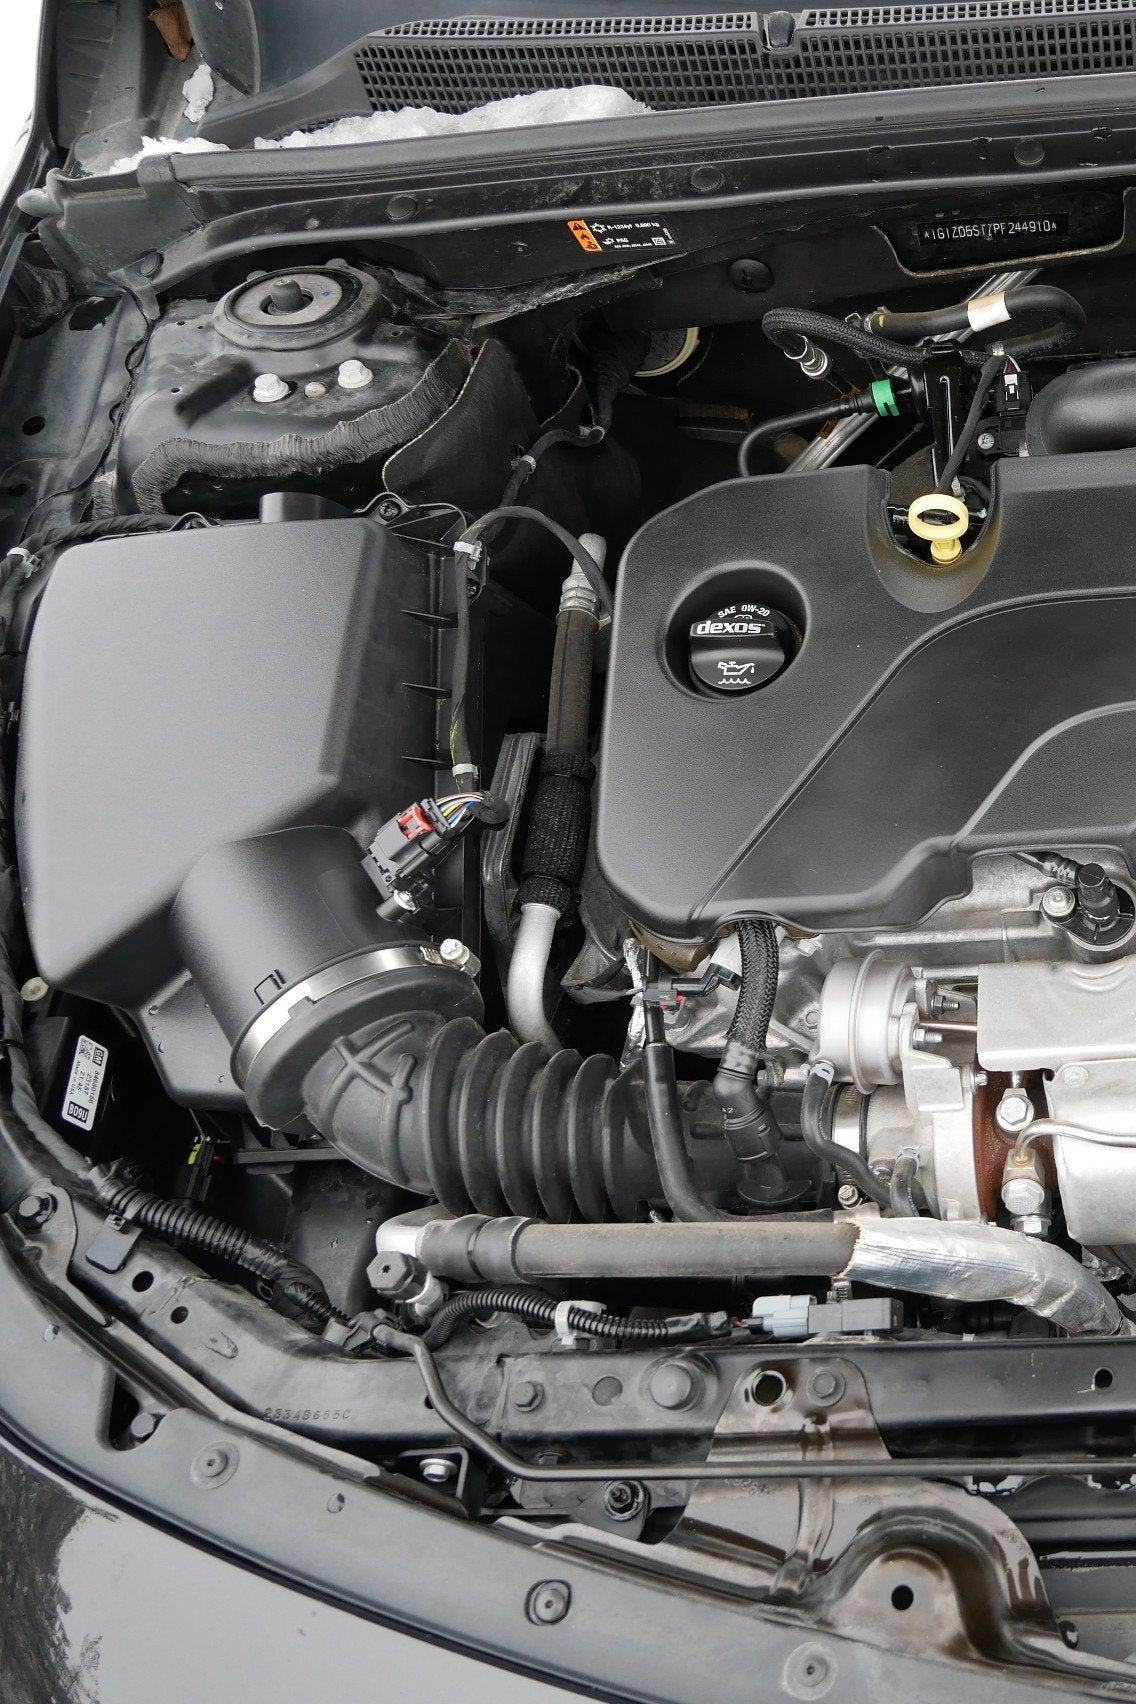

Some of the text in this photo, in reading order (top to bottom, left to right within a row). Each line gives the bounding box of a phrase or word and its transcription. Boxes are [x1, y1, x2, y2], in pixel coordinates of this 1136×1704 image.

[717, 604, 770, 618] SAE 0W-20
[68, 1103, 89, 1123] BD9U
